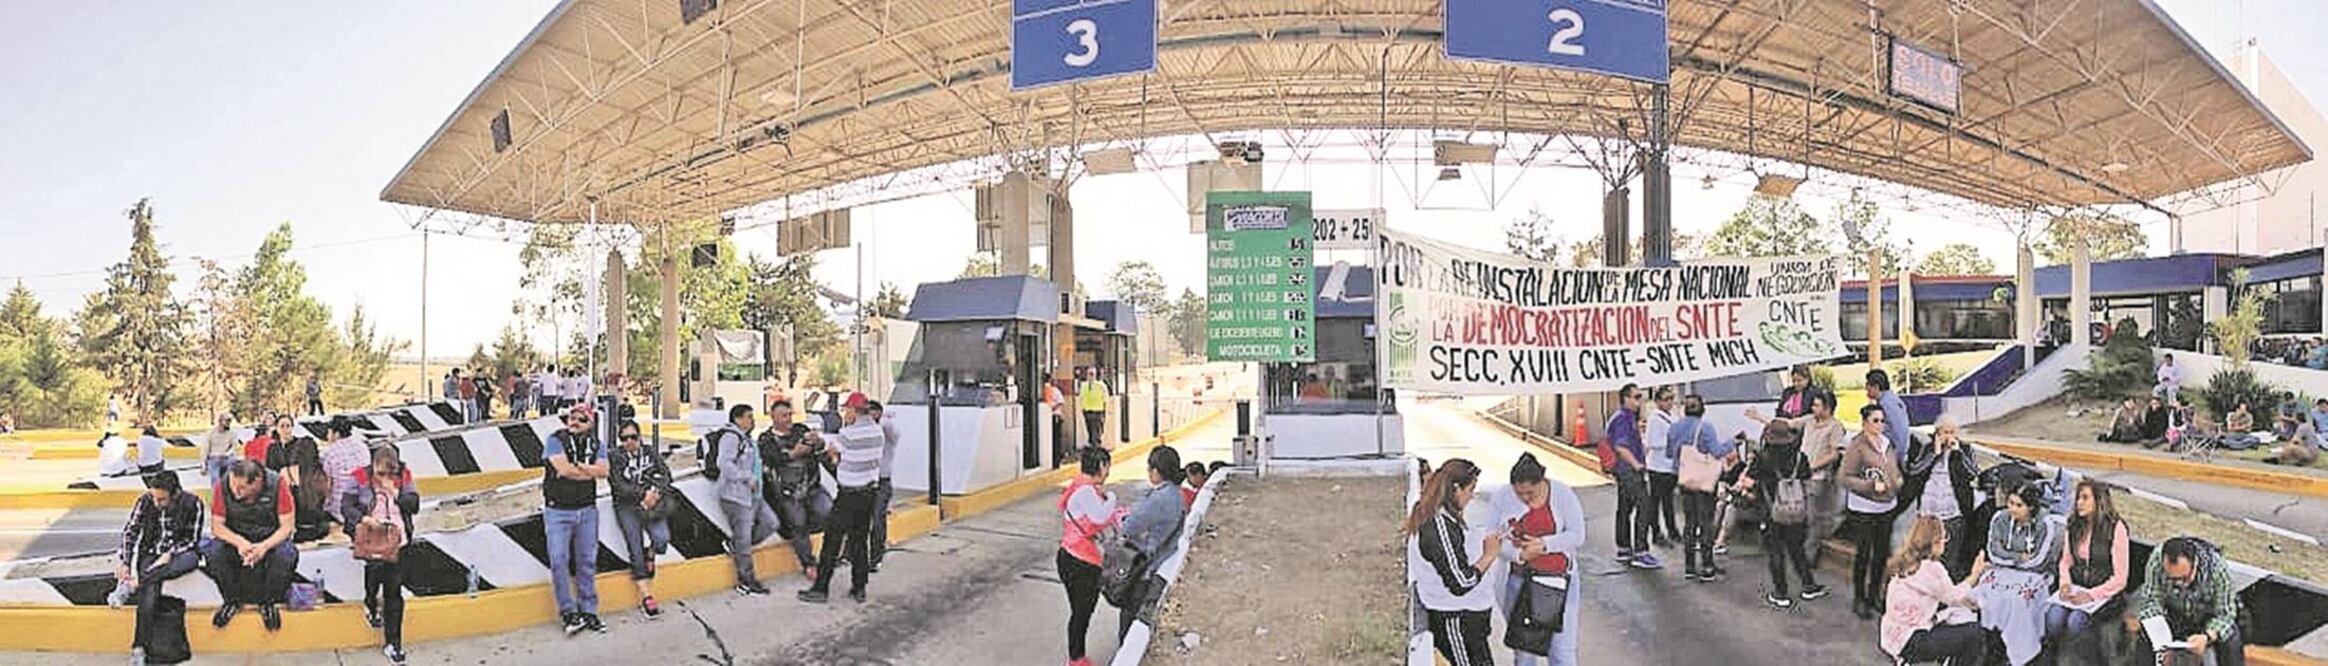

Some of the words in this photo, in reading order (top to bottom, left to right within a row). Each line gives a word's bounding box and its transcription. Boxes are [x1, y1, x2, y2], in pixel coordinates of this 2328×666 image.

[1063, 19, 1099, 66] 3
[1549, 9, 1585, 55] 2
[1313, 218, 1336, 240] 202
[1379, 234, 1423, 290] POR
[1428, 264, 1450, 293] LA
[1606, 269, 1621, 286] DE
[1451, 258, 1605, 307] REINSTALACION
[1604, 287, 1618, 303] LA
[1622, 268, 1672, 303] MESA
[1677, 264, 1752, 301] NACIONAL
[1433, 320, 1455, 342] LA
[1462, 303, 1649, 347] DEMOCRATIZACION
[1650, 315, 1677, 343] DEL
[1676, 302, 1743, 341] SNTE
[1769, 299, 1824, 332] CNTE
[1509, 349, 1570, 384] XVIII
[1579, 343, 1700, 379] CNTE-SNTE
